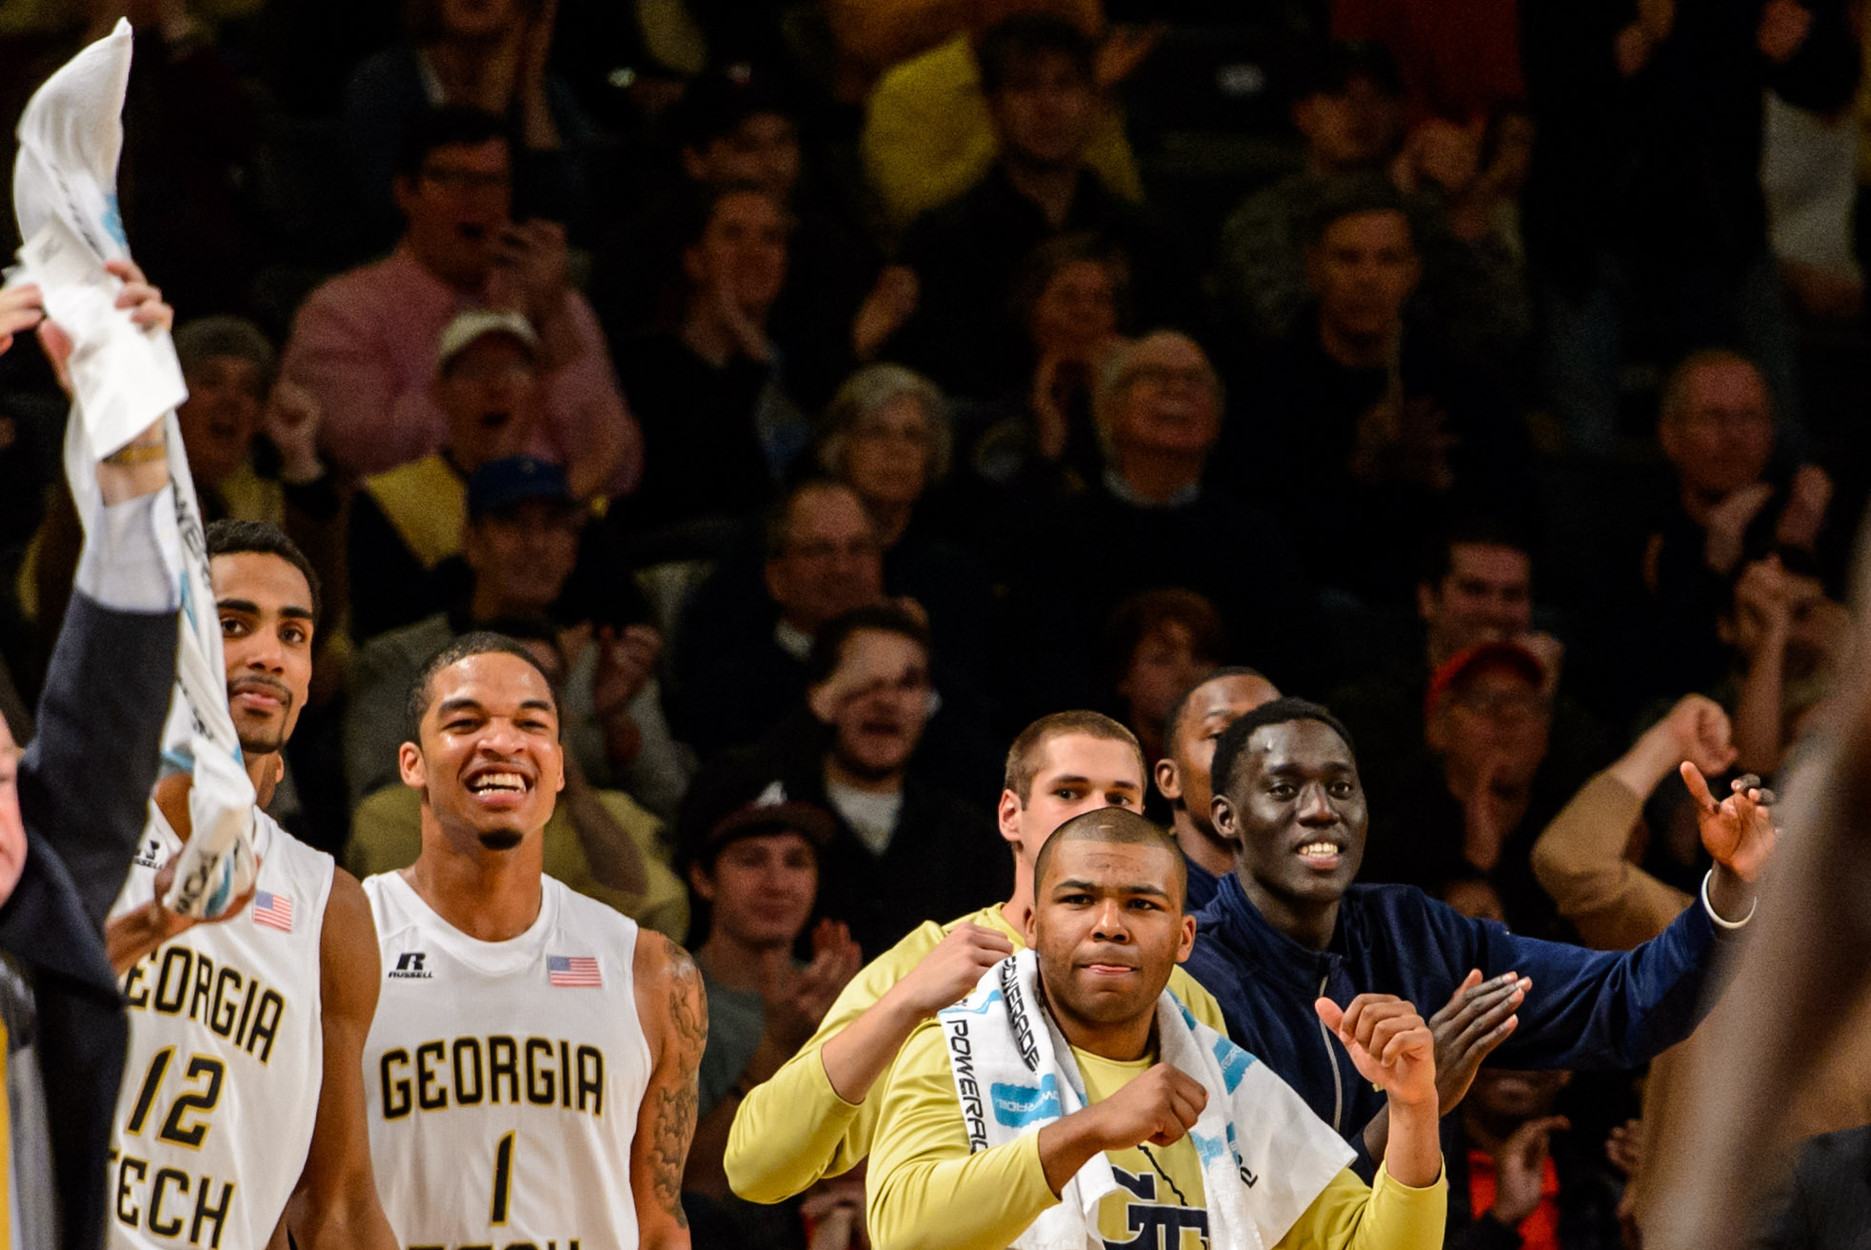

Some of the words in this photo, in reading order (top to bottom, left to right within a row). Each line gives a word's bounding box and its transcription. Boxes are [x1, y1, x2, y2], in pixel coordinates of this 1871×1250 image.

[123, 945, 287, 1068] EORGIA
[388, 971, 434, 979] RUSSELL
[125, 1045, 227, 1152] 12
[379, 1034, 607, 1122] GEORGIA
[488, 1129, 517, 1227] 1
